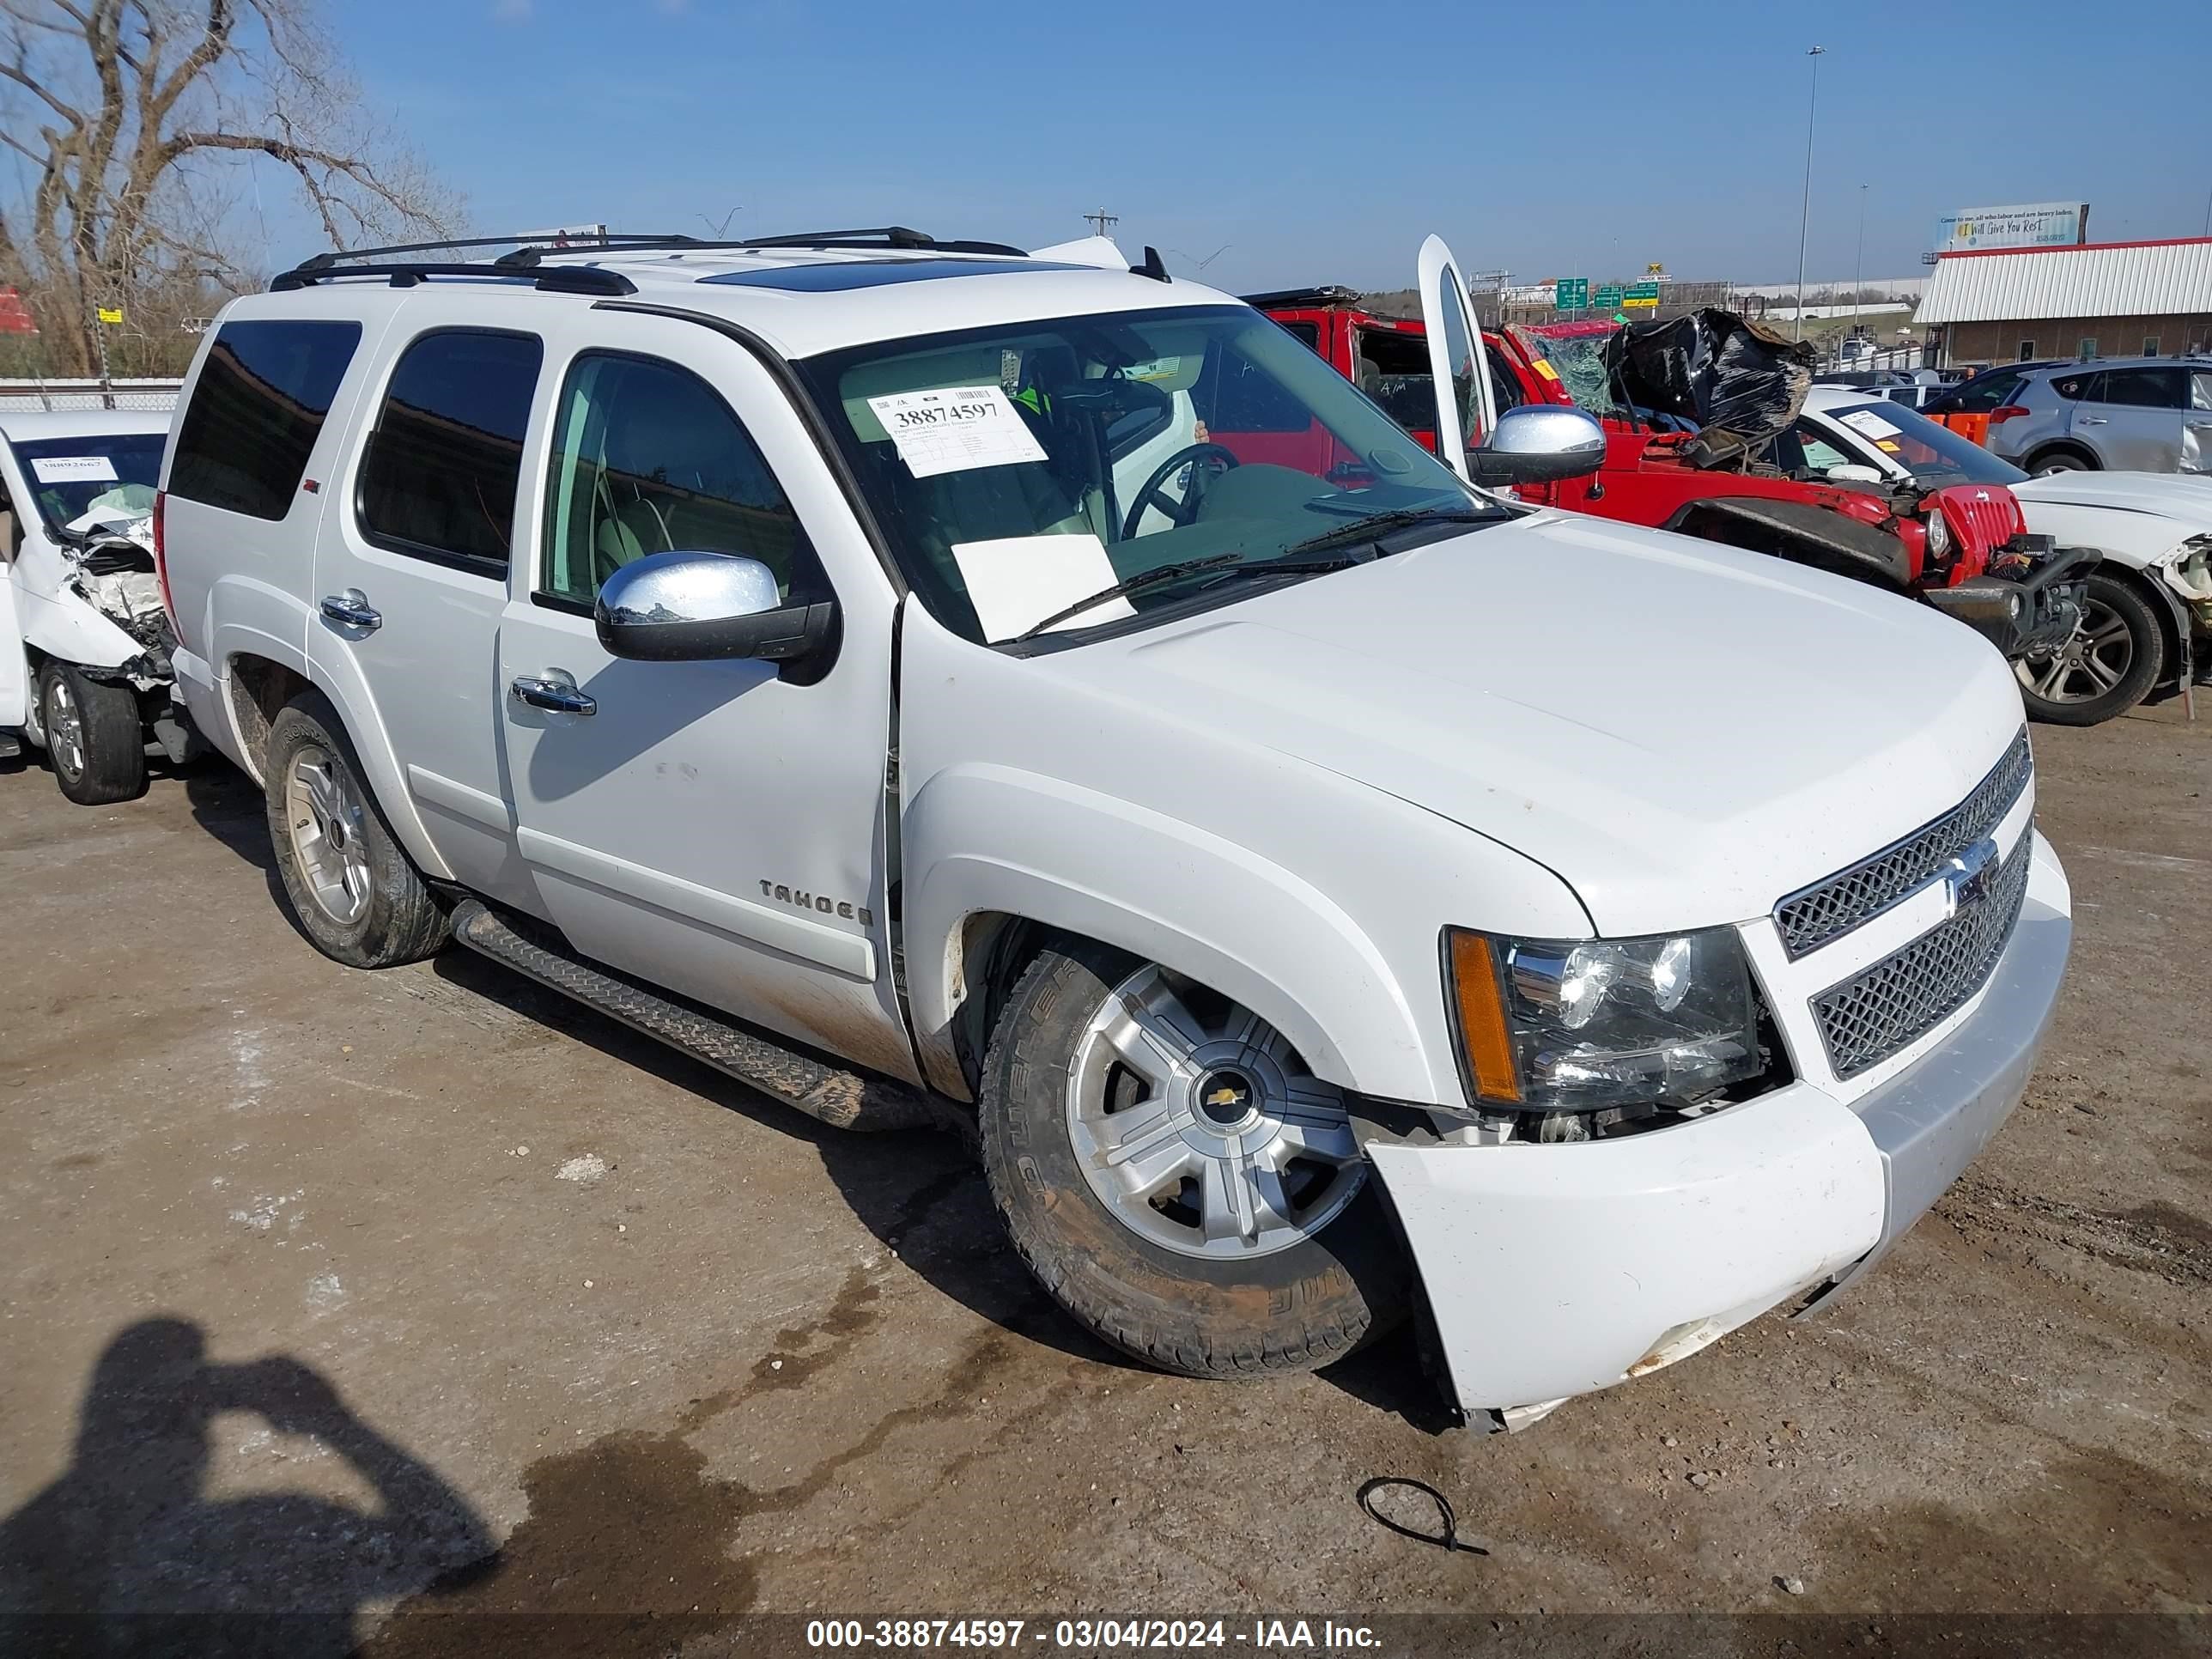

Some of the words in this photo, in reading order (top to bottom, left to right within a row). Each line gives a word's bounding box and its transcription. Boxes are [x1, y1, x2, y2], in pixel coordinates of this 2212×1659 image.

[1963, 223, 1970, 236] I
[1971, 222, 1985, 236] Will
[1988, 221, 2004, 235] Give
[2007, 220, 2021, 234] You
[894, 403, 998, 428] 38874597
[759, 879, 855, 920] TAHOE
